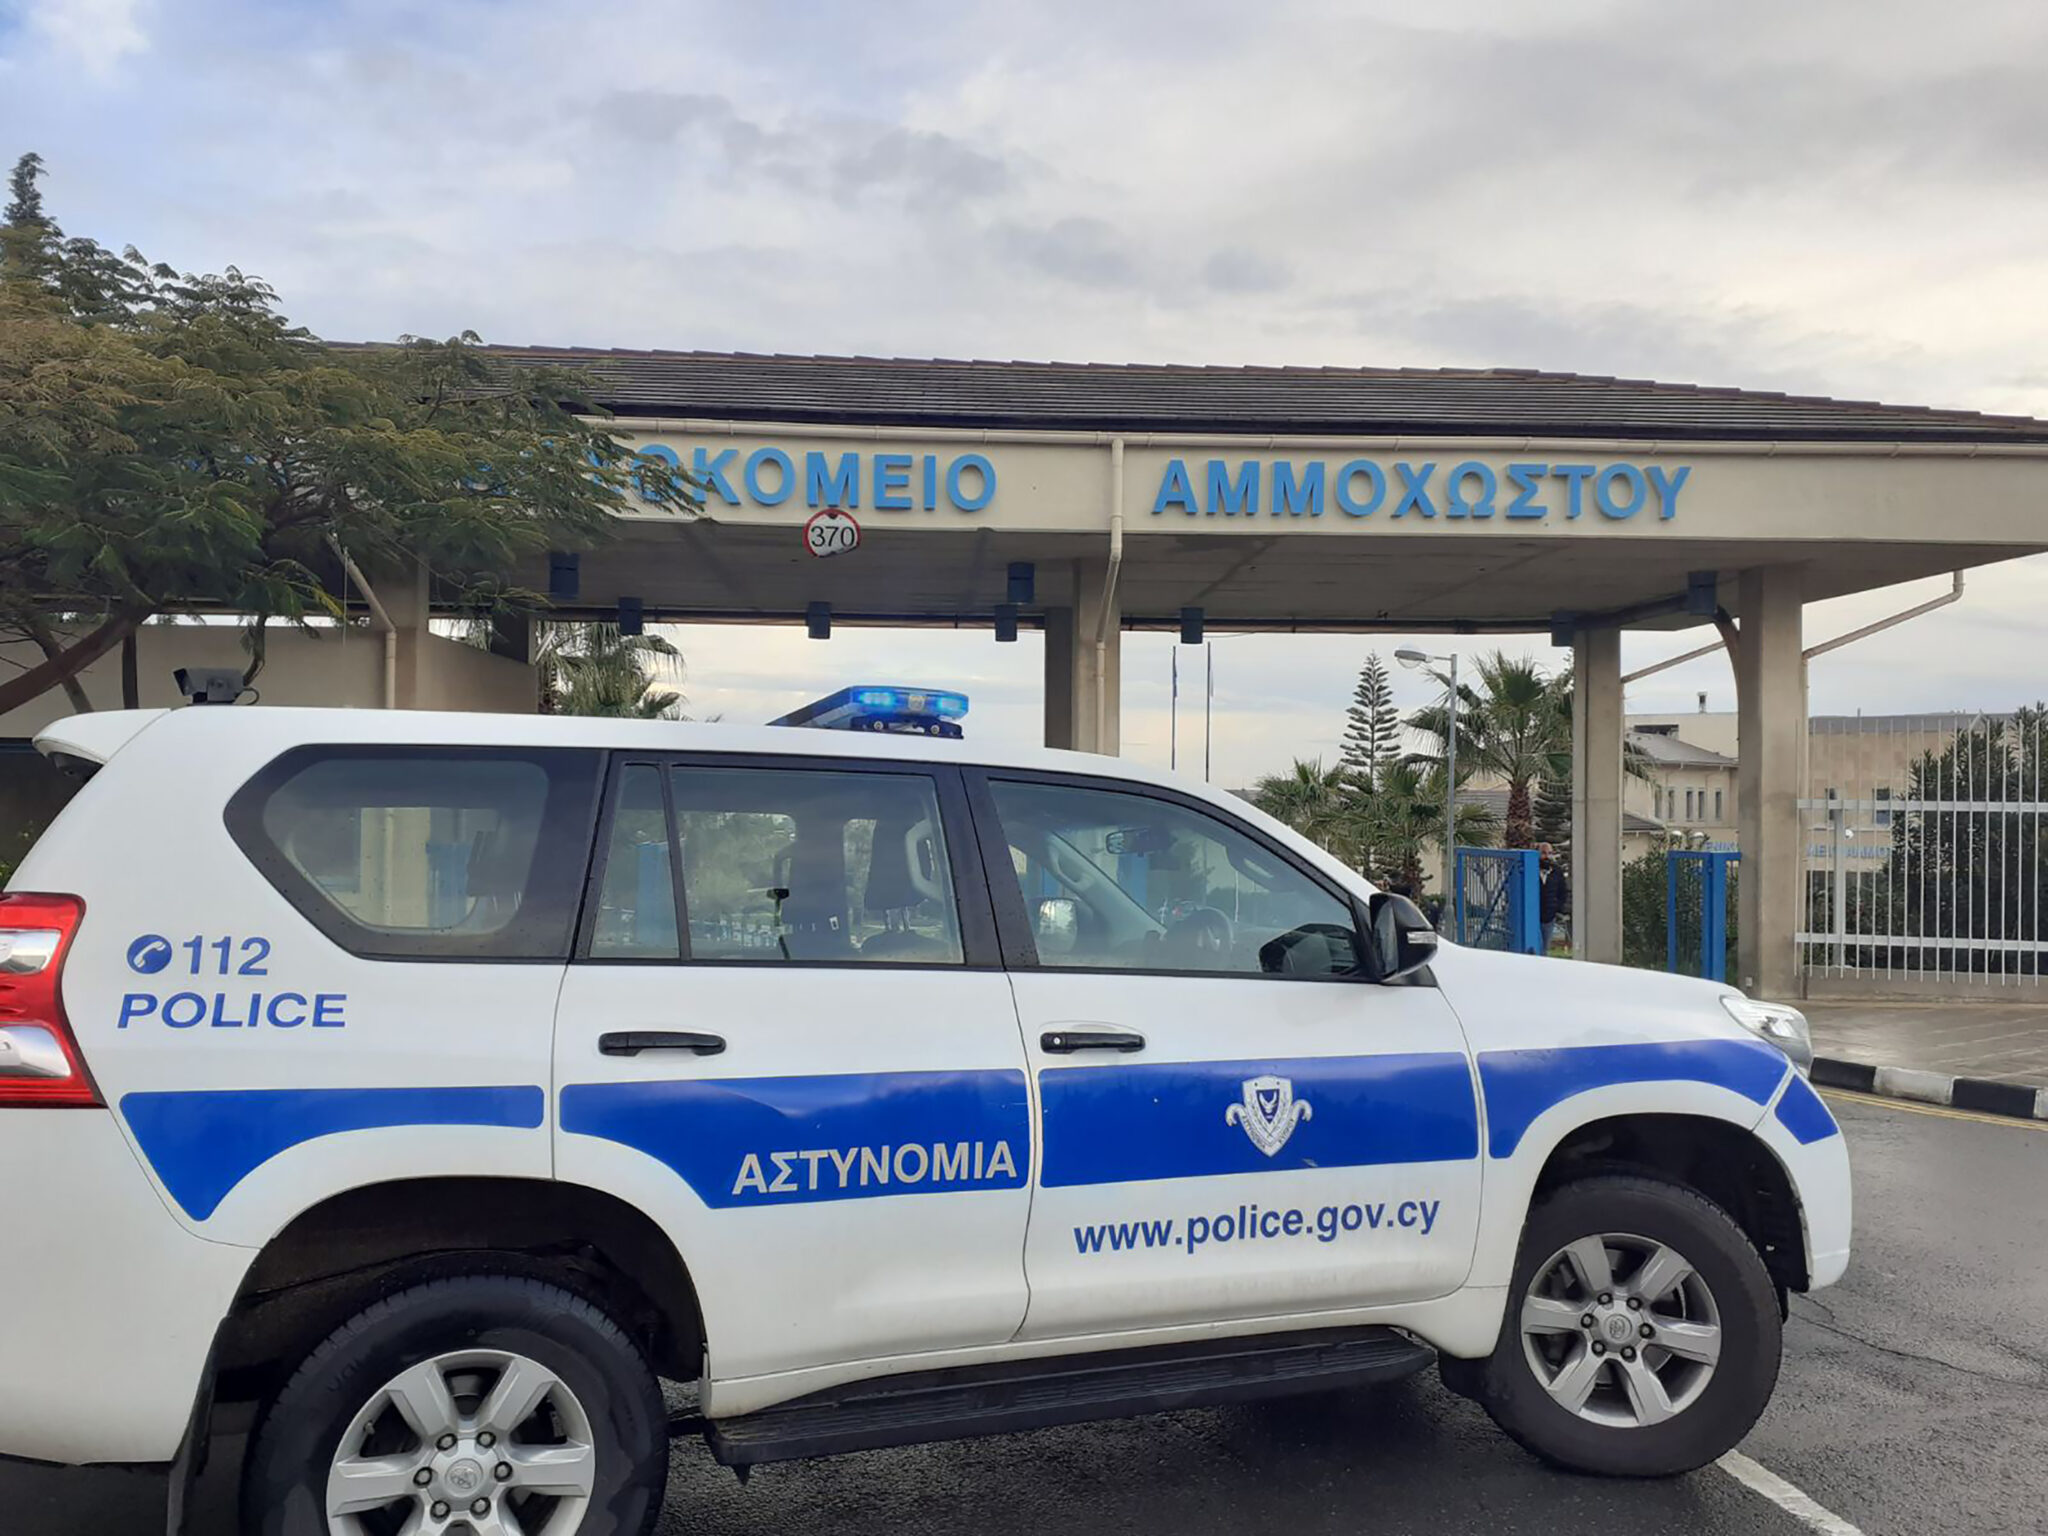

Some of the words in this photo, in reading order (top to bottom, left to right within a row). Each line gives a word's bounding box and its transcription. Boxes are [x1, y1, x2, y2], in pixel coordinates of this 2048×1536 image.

[1153, 459, 1690, 519] ΑΜΜΟΧΩΣΤΟΥ
[811, 525, 855, 548] 370
[183, 935, 271, 976] 112
[117, 992, 347, 1029] POLICE
[731, 1140, 1018, 1195] ΑΣΤΥΝΟΜΙΑ
[1072, 1200, 1440, 1254] www.police.gov.cy
